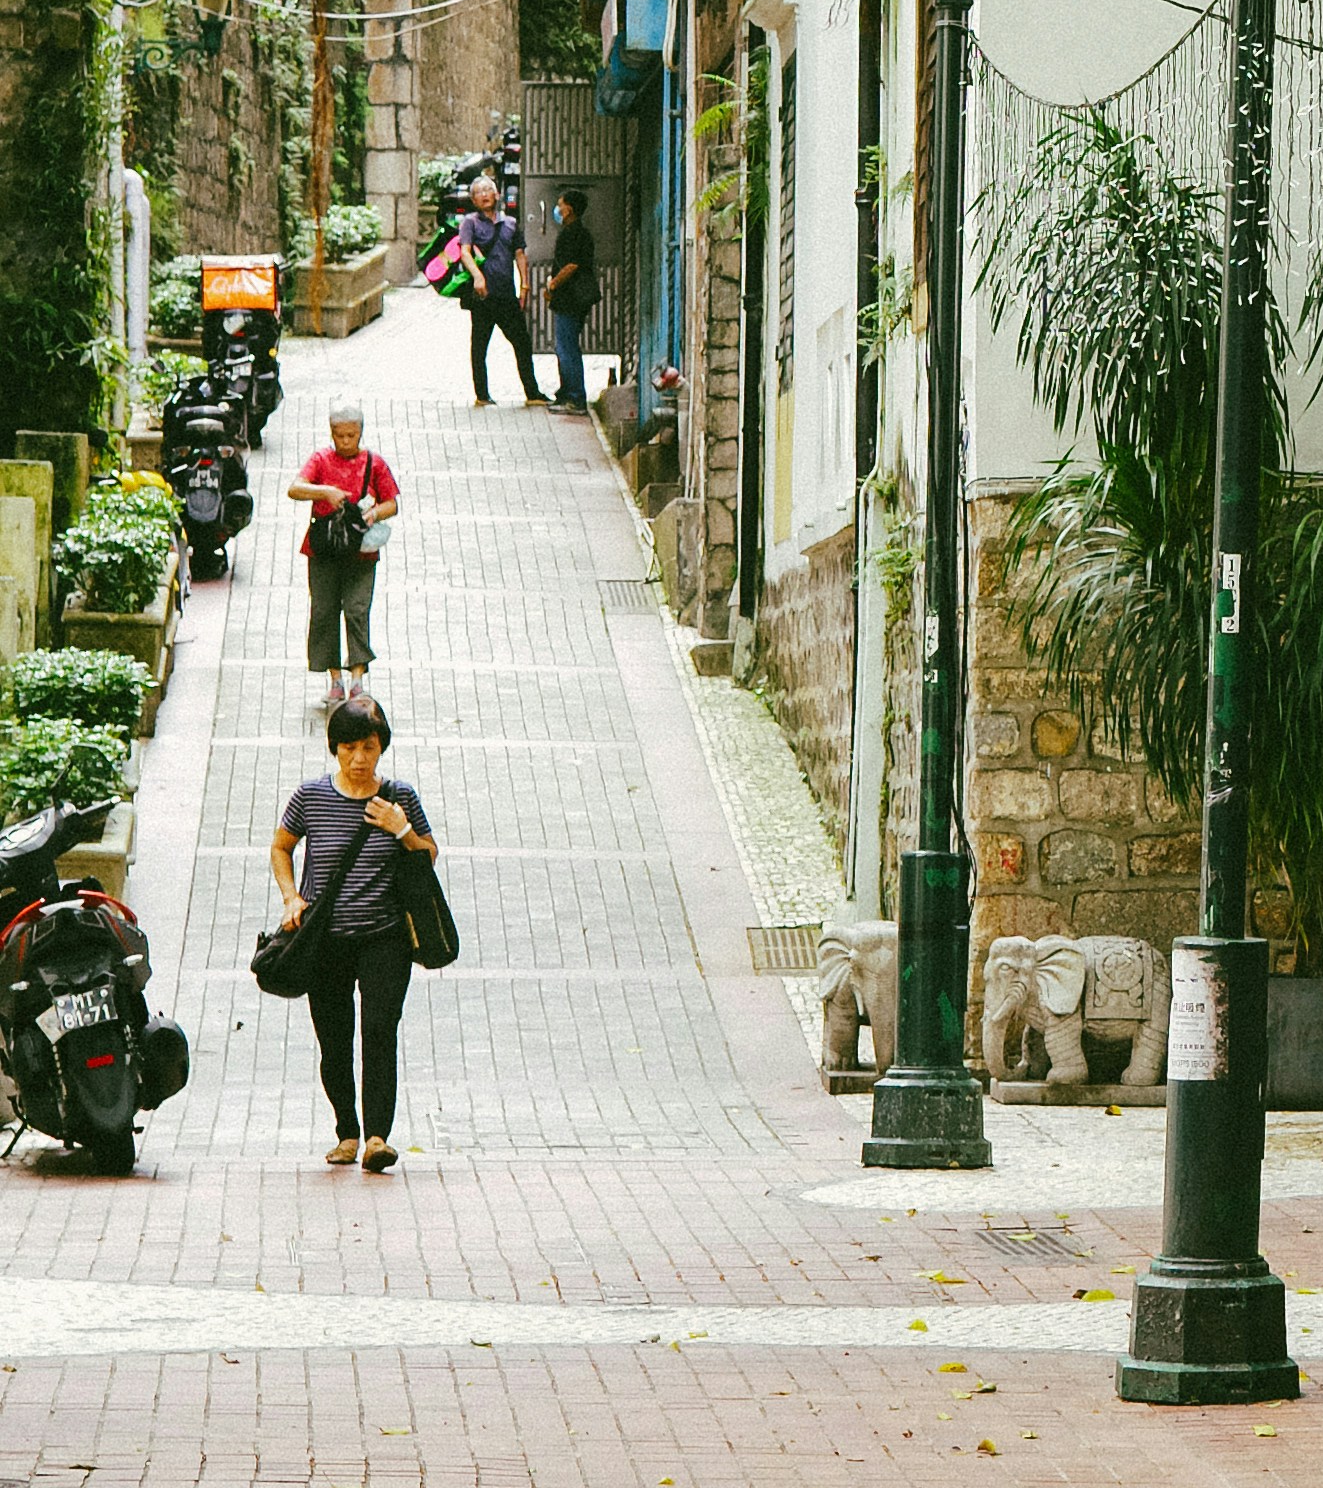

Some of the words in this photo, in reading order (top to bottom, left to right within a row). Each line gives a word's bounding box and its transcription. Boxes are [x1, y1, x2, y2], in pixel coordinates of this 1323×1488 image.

[1226, 558, 1237, 632] 152
[71, 991, 93, 1010] MT
[63, 1004, 111, 1030] 81-71
